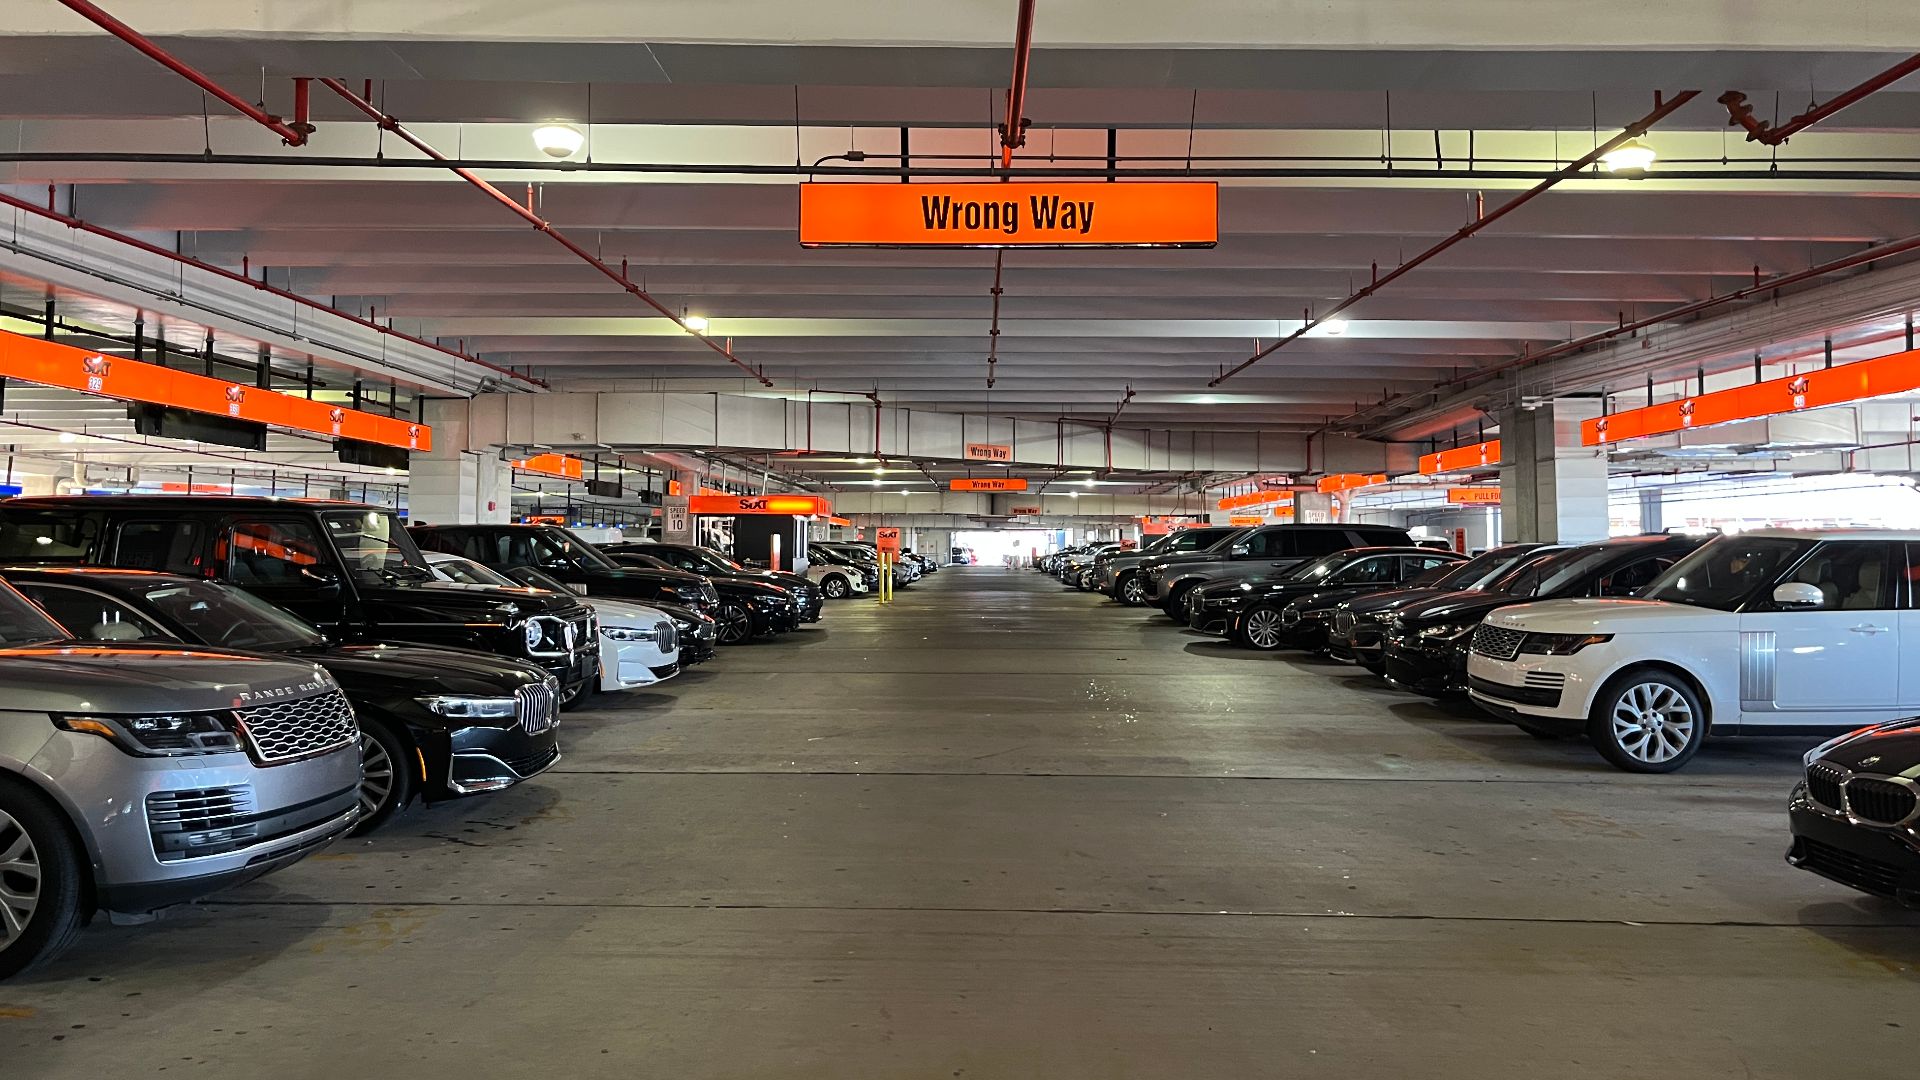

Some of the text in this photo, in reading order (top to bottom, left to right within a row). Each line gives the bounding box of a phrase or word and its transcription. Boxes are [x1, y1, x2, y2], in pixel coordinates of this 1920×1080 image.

[921, 195, 1095, 235] Wrong Way
[90, 377, 102, 390] 329
[970, 447, 1006, 459] Wrong Way
[972, 480, 1004, 488] Wrong Way
[672, 520, 682, 530] 10
[240, 686, 294, 701] RANGE
